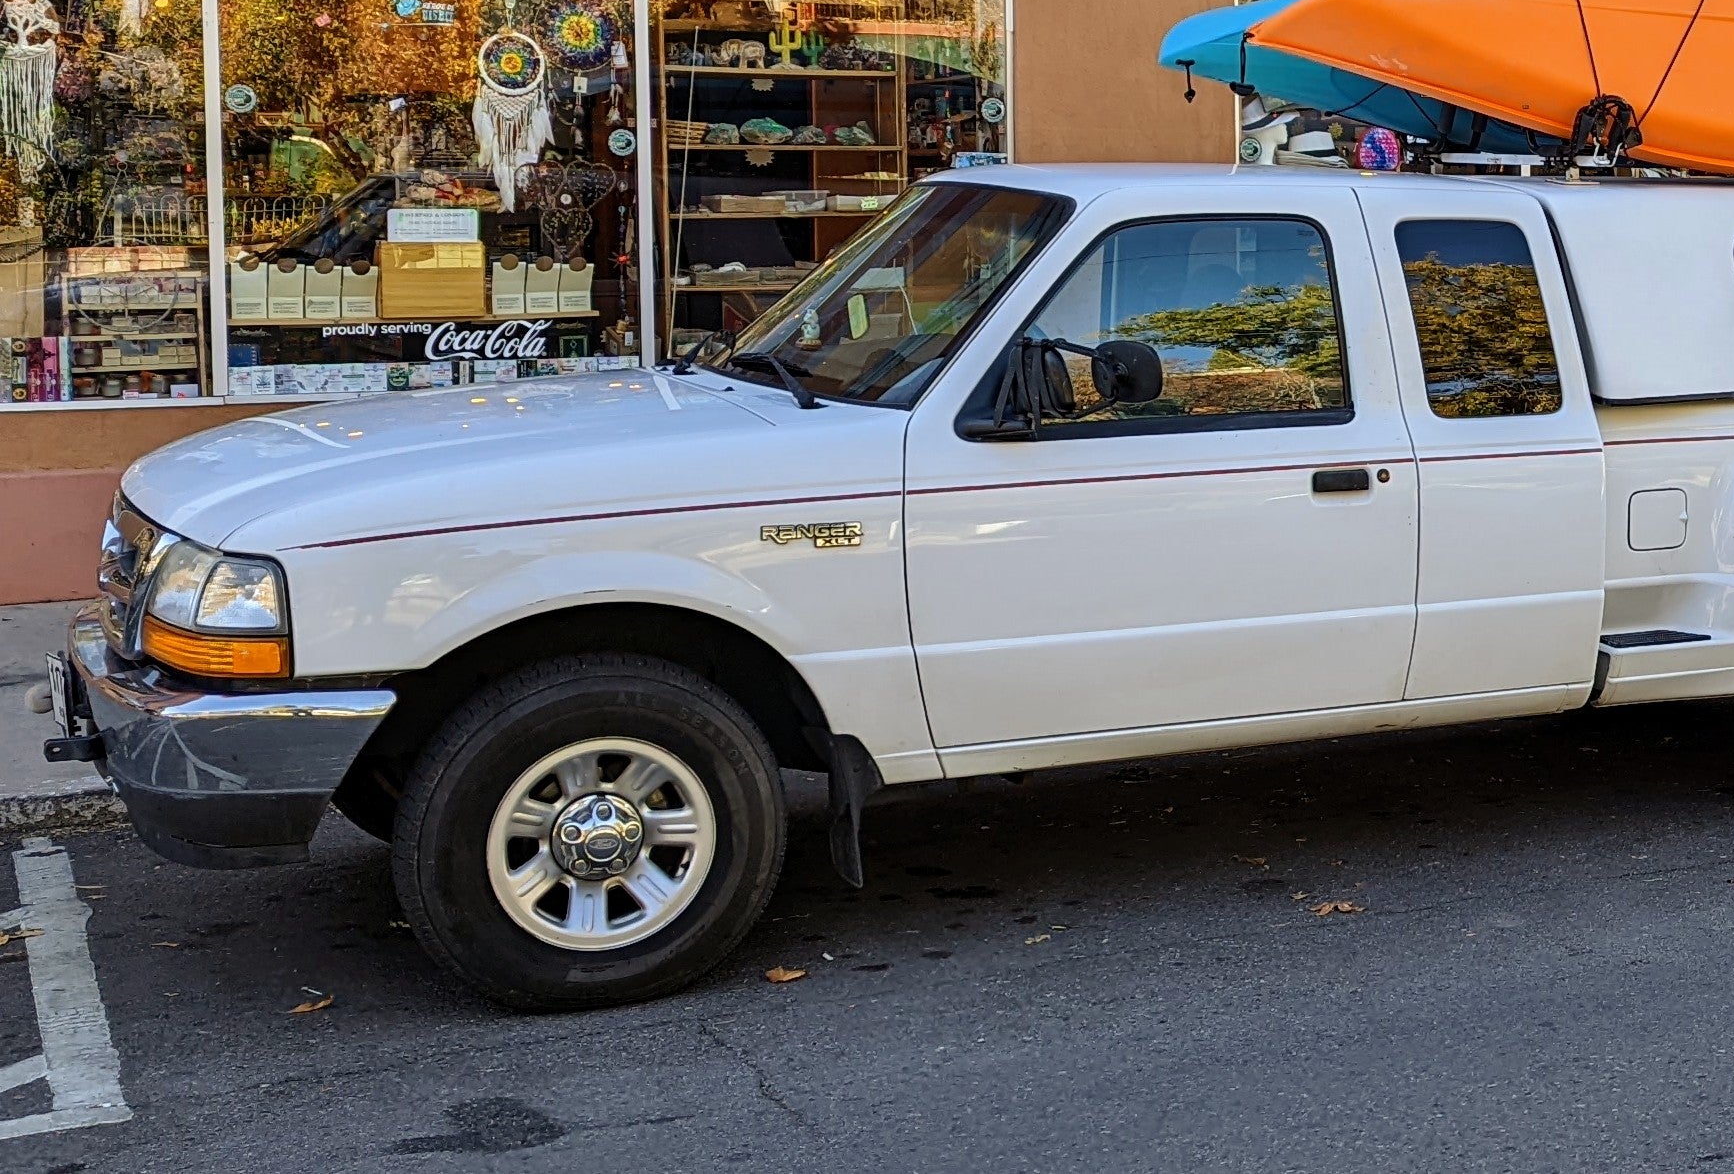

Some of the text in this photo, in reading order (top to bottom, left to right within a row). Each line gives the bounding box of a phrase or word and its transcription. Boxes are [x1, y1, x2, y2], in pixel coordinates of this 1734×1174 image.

[322, 321, 432, 338] proudly serving
[424, 319, 553, 361] Coca-Cola
[817, 537, 859, 546] XLT
